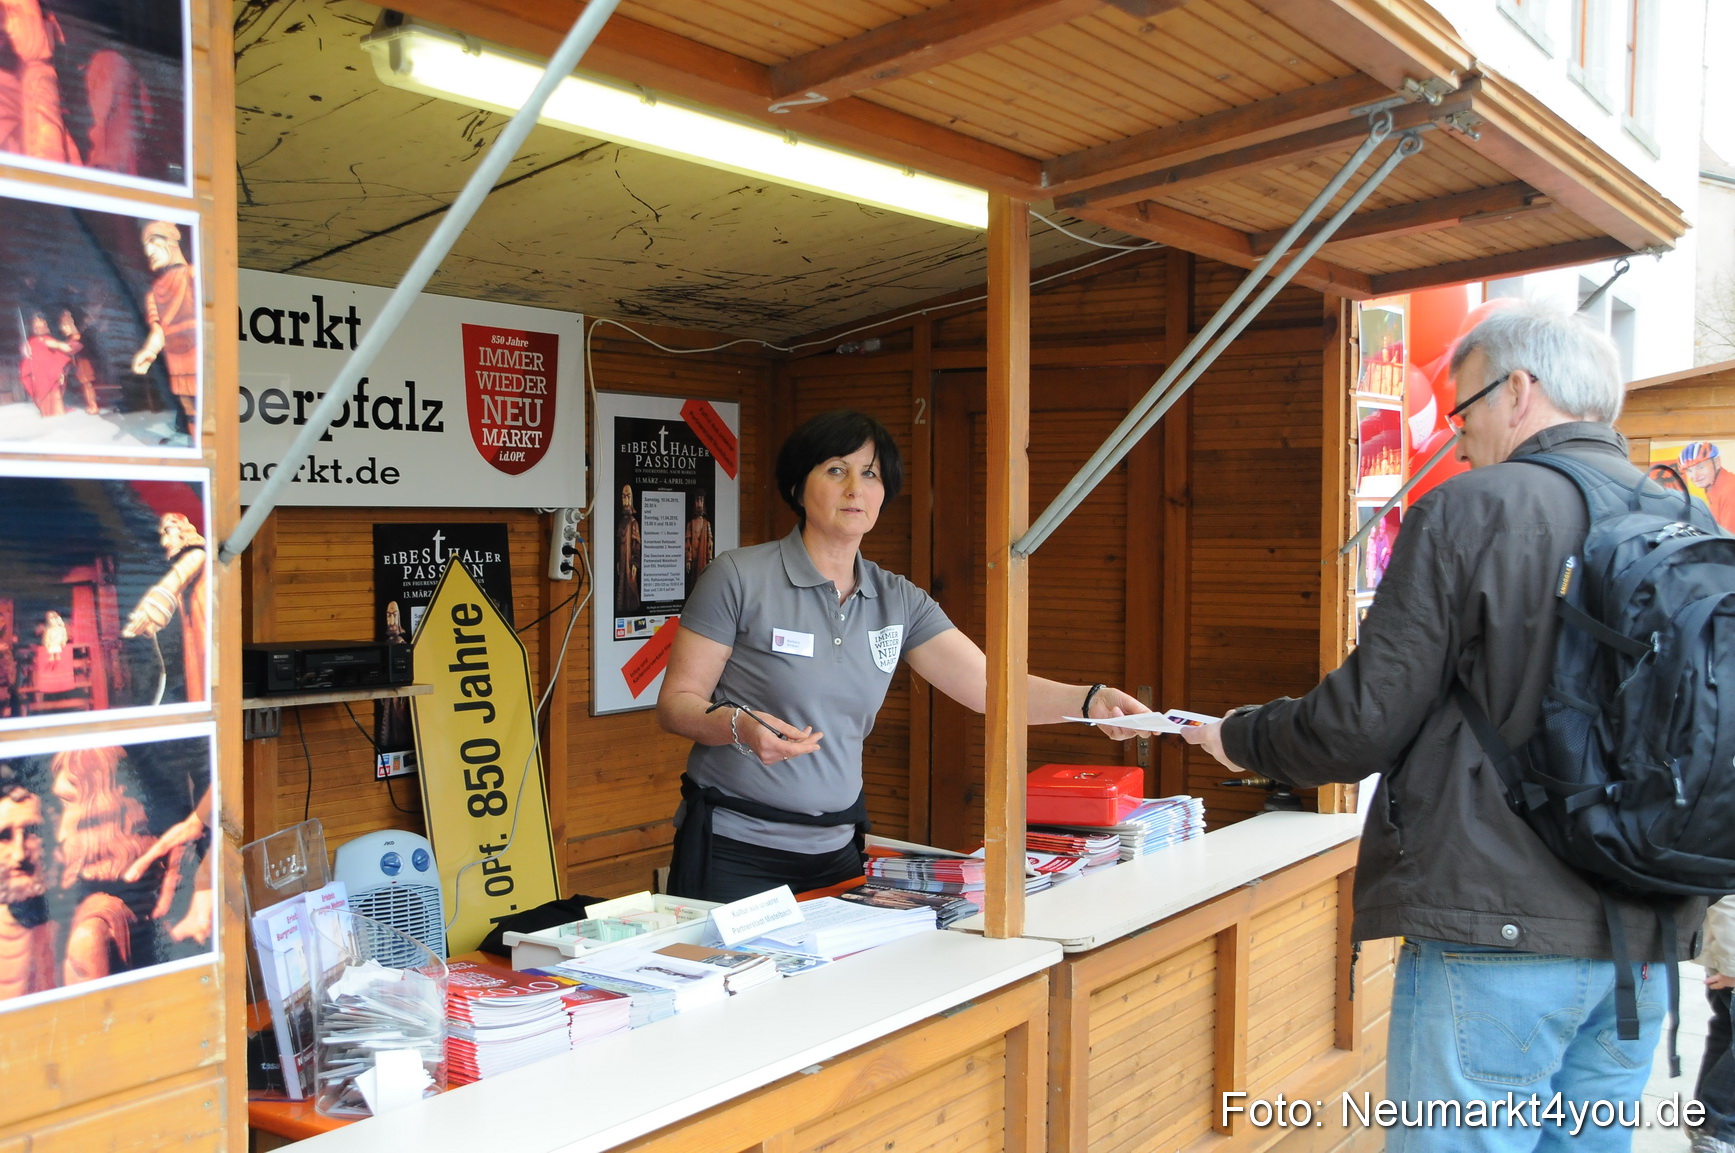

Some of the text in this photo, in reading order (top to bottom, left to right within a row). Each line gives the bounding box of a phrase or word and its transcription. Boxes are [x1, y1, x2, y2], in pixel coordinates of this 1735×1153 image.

[490, 334, 529, 348] 850 Jahre
[478, 346, 545, 372] IMMER
[475, 369, 548, 395] WIEDER
[480, 394, 544, 429] NEU
[914, 397, 927, 425] 2
[481, 427, 543, 449] MARKT
[635, 454, 697, 470] PASSION
[402, 564, 484, 580] PASSN
[411, 590, 433, 599] MÄRZ
[874, 631, 899, 643] IMMER
[874, 638, 899, 649] WIEDER
[877, 646, 897, 659] NEU
[447, 602, 497, 724] Jahre
[459, 737, 509, 818] 850
[731, 908, 793, 935] Partnerstadt Mistelbach
[463, 981, 560, 998] 2010
